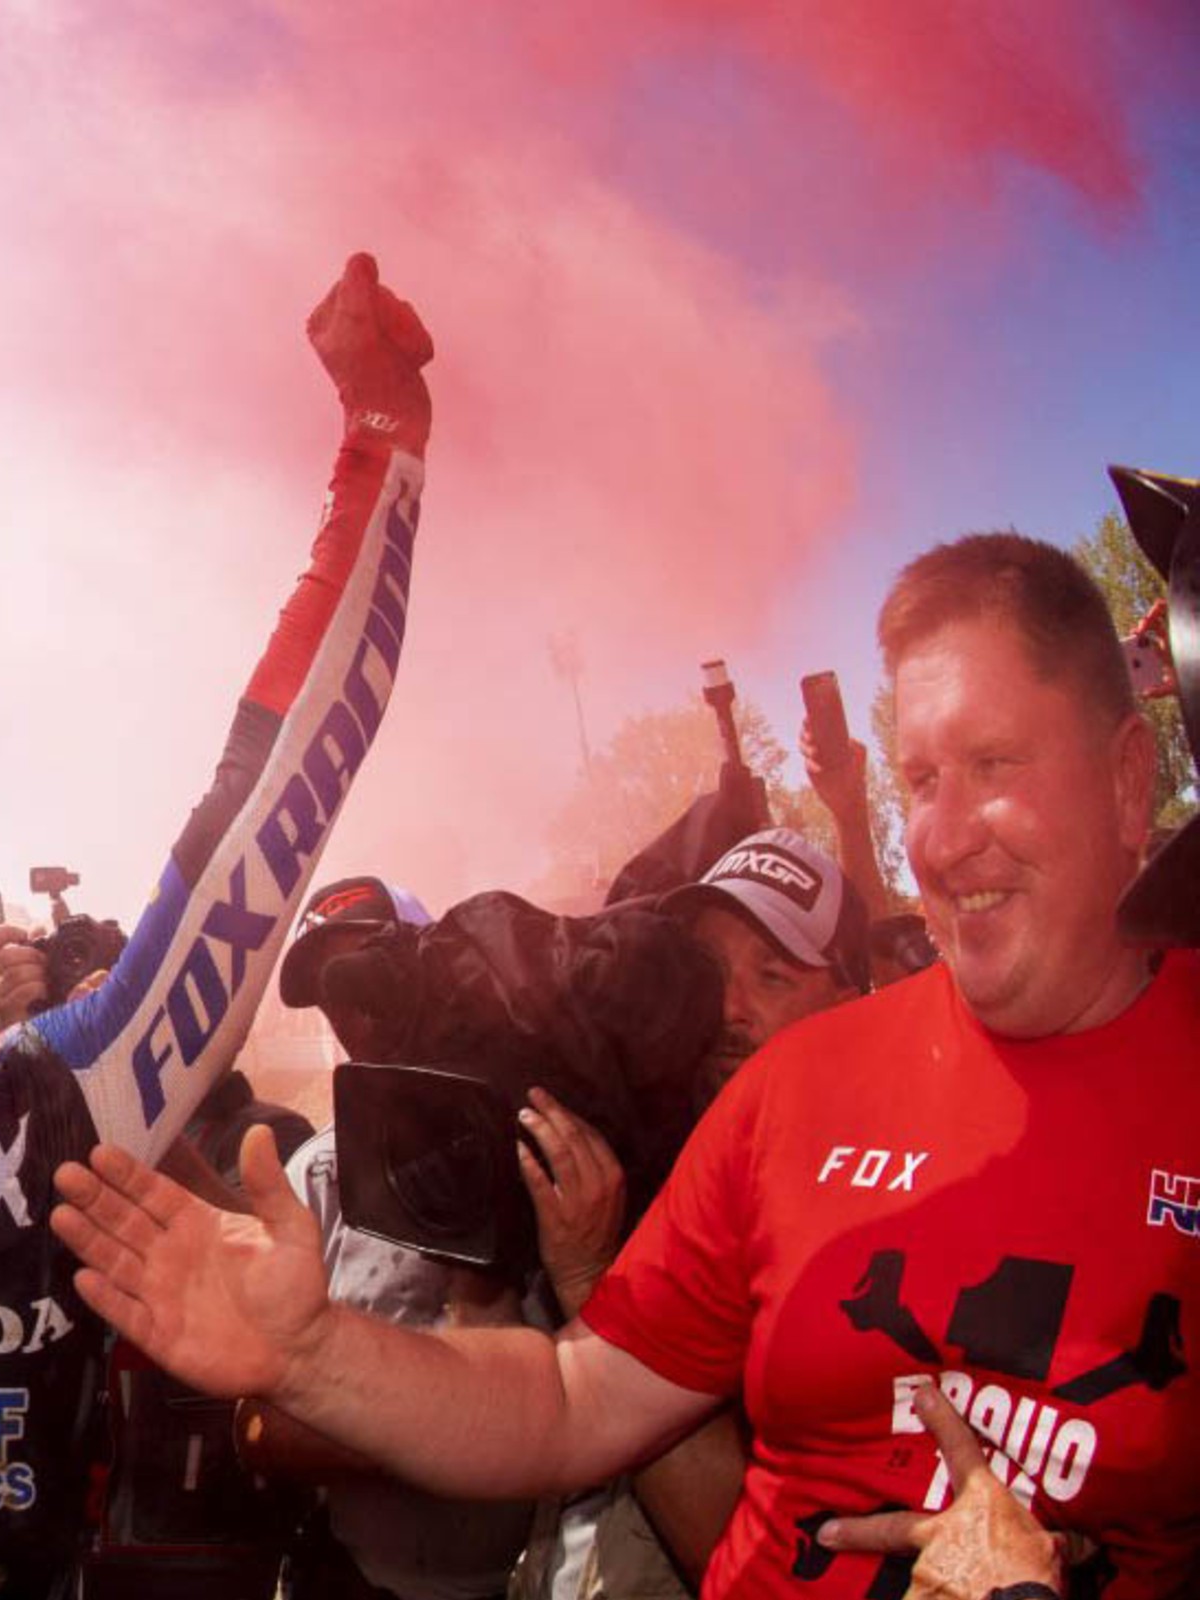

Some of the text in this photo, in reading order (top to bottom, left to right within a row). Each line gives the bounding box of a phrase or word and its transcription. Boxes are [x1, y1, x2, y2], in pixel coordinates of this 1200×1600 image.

[716, 850, 817, 891] MXGP
[131, 854, 278, 1131] FOX
[817, 1146, 930, 1191] FOX
